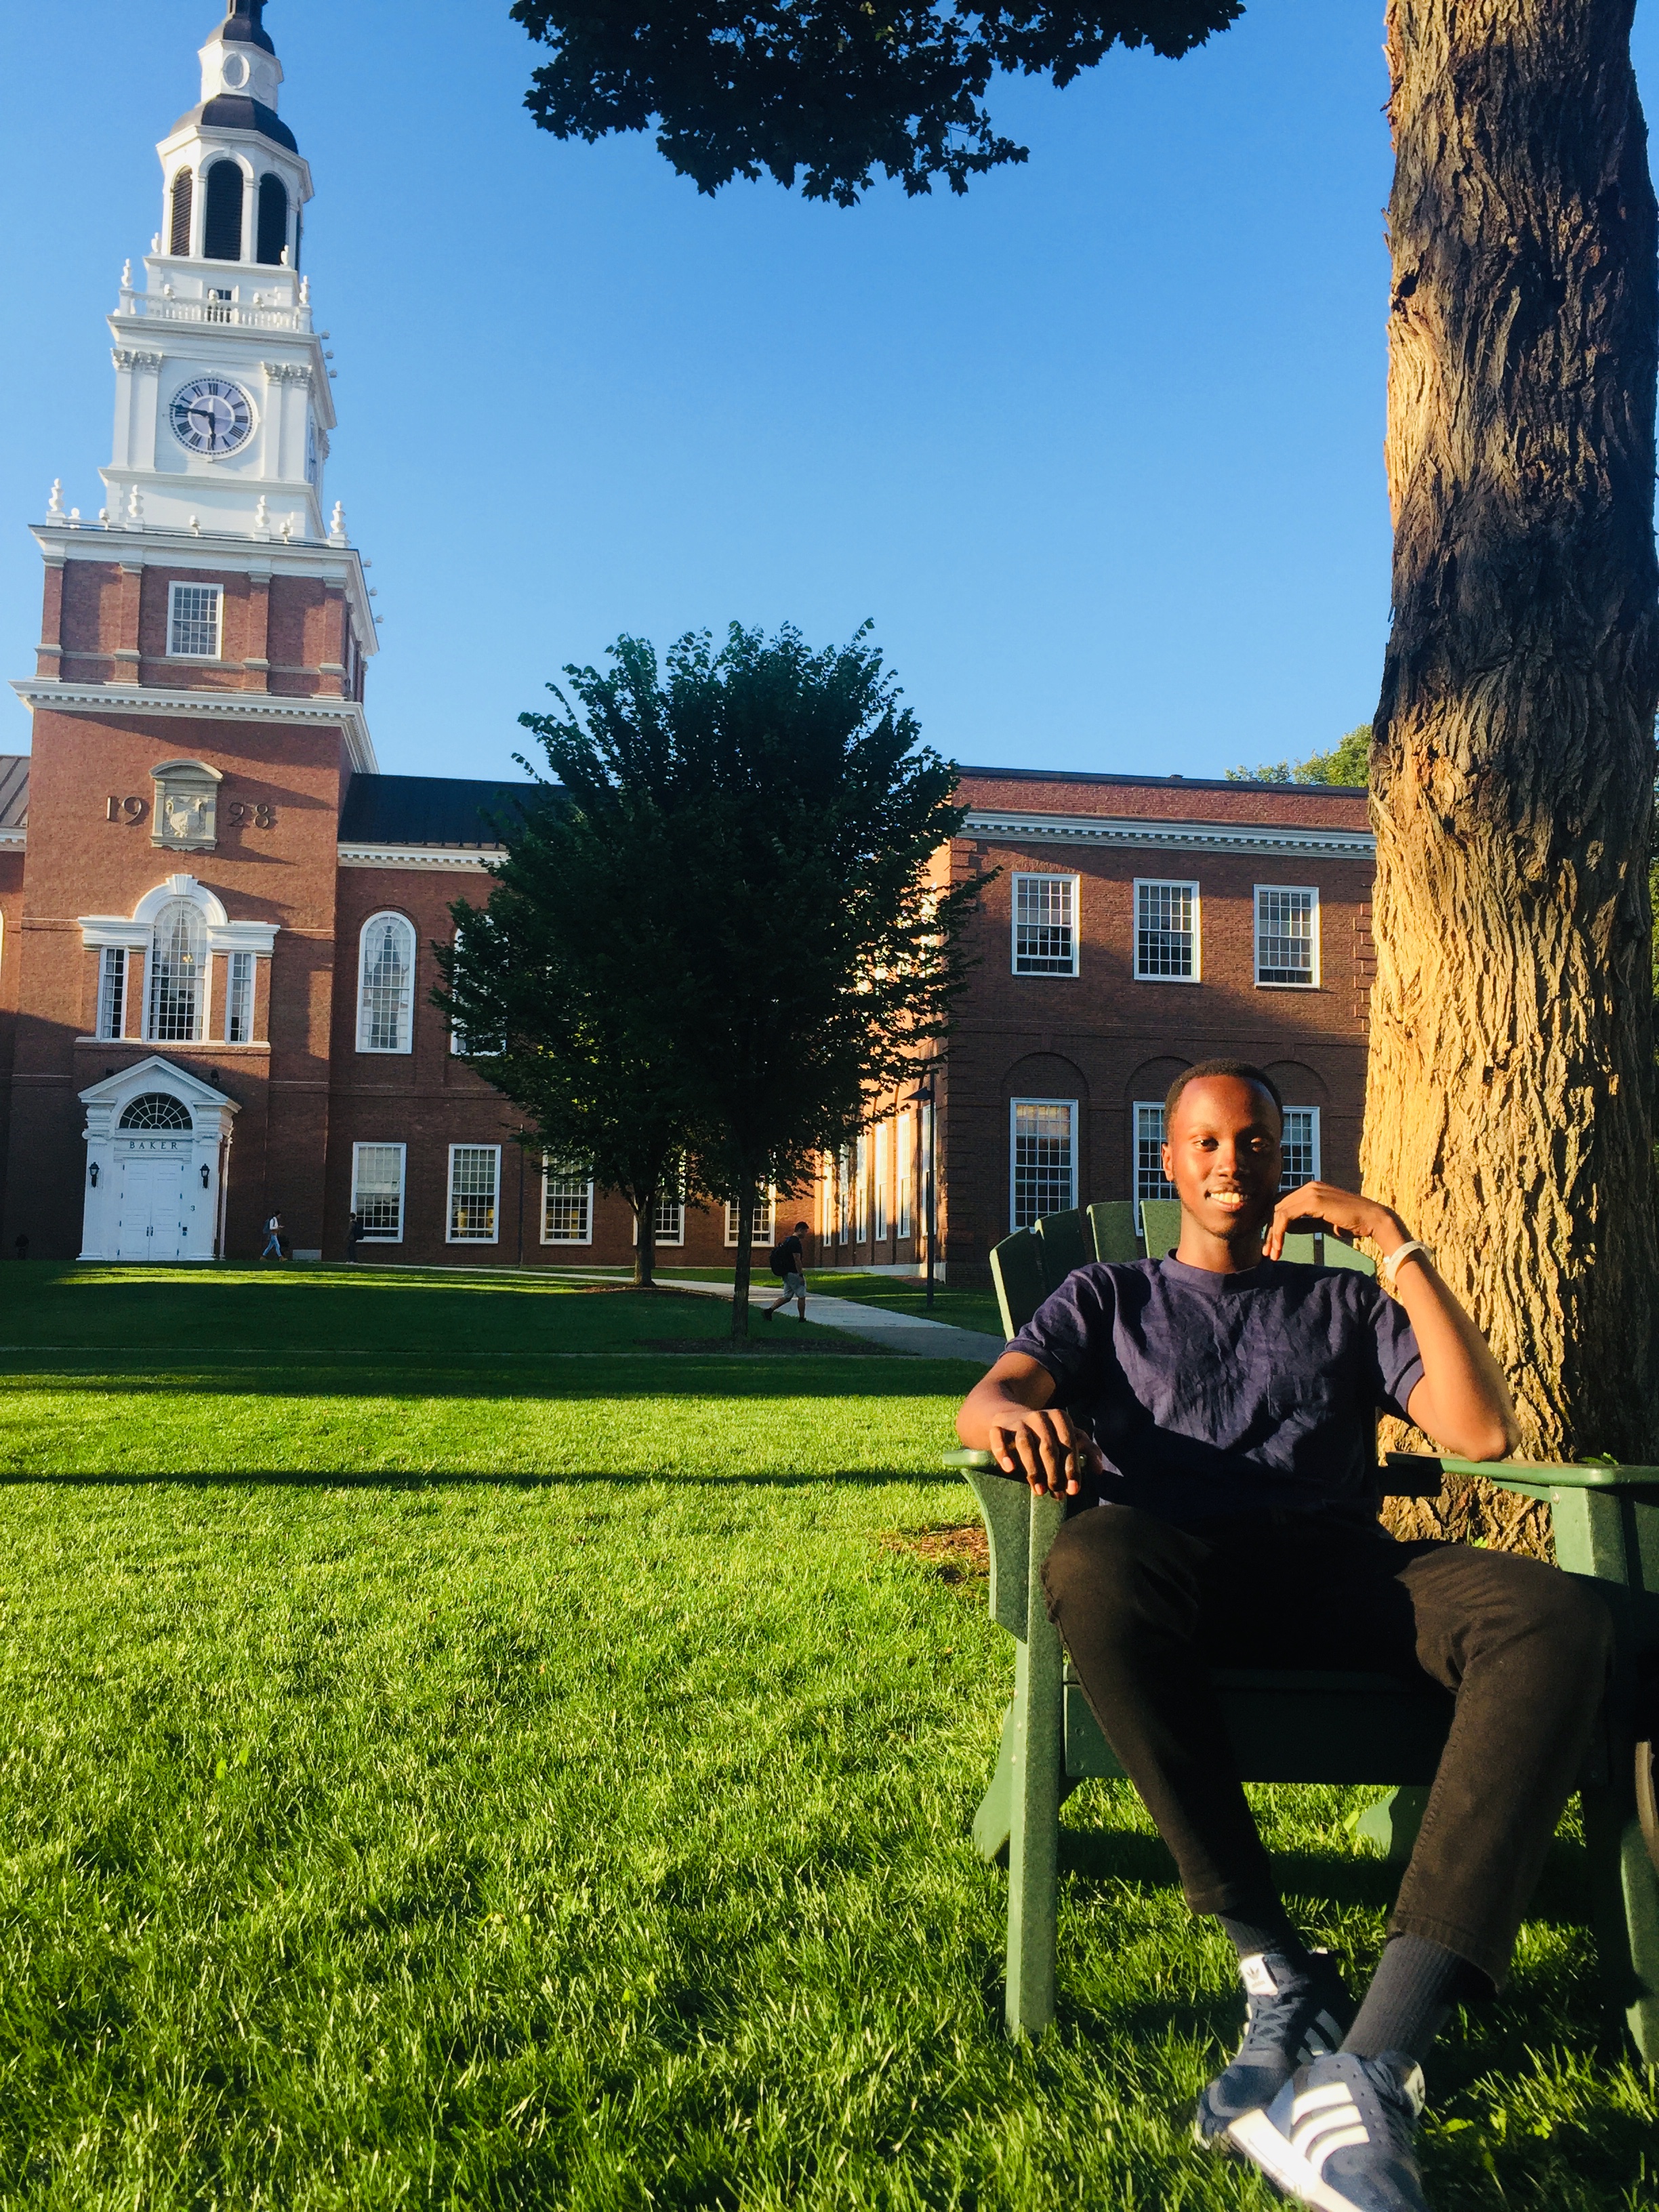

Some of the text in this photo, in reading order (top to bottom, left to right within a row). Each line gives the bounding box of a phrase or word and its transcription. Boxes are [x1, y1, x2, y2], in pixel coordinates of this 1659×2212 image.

[191, 385, 203, 398] XI
[208, 383, 218, 396] XII
[224, 389, 232, 399] I
[180, 396, 192, 405] X
[232, 401, 245, 409] II
[234, 415, 248, 424] III
[106, 796, 270, 829] 19 28
[129, 1141, 178, 1149] BAKER
